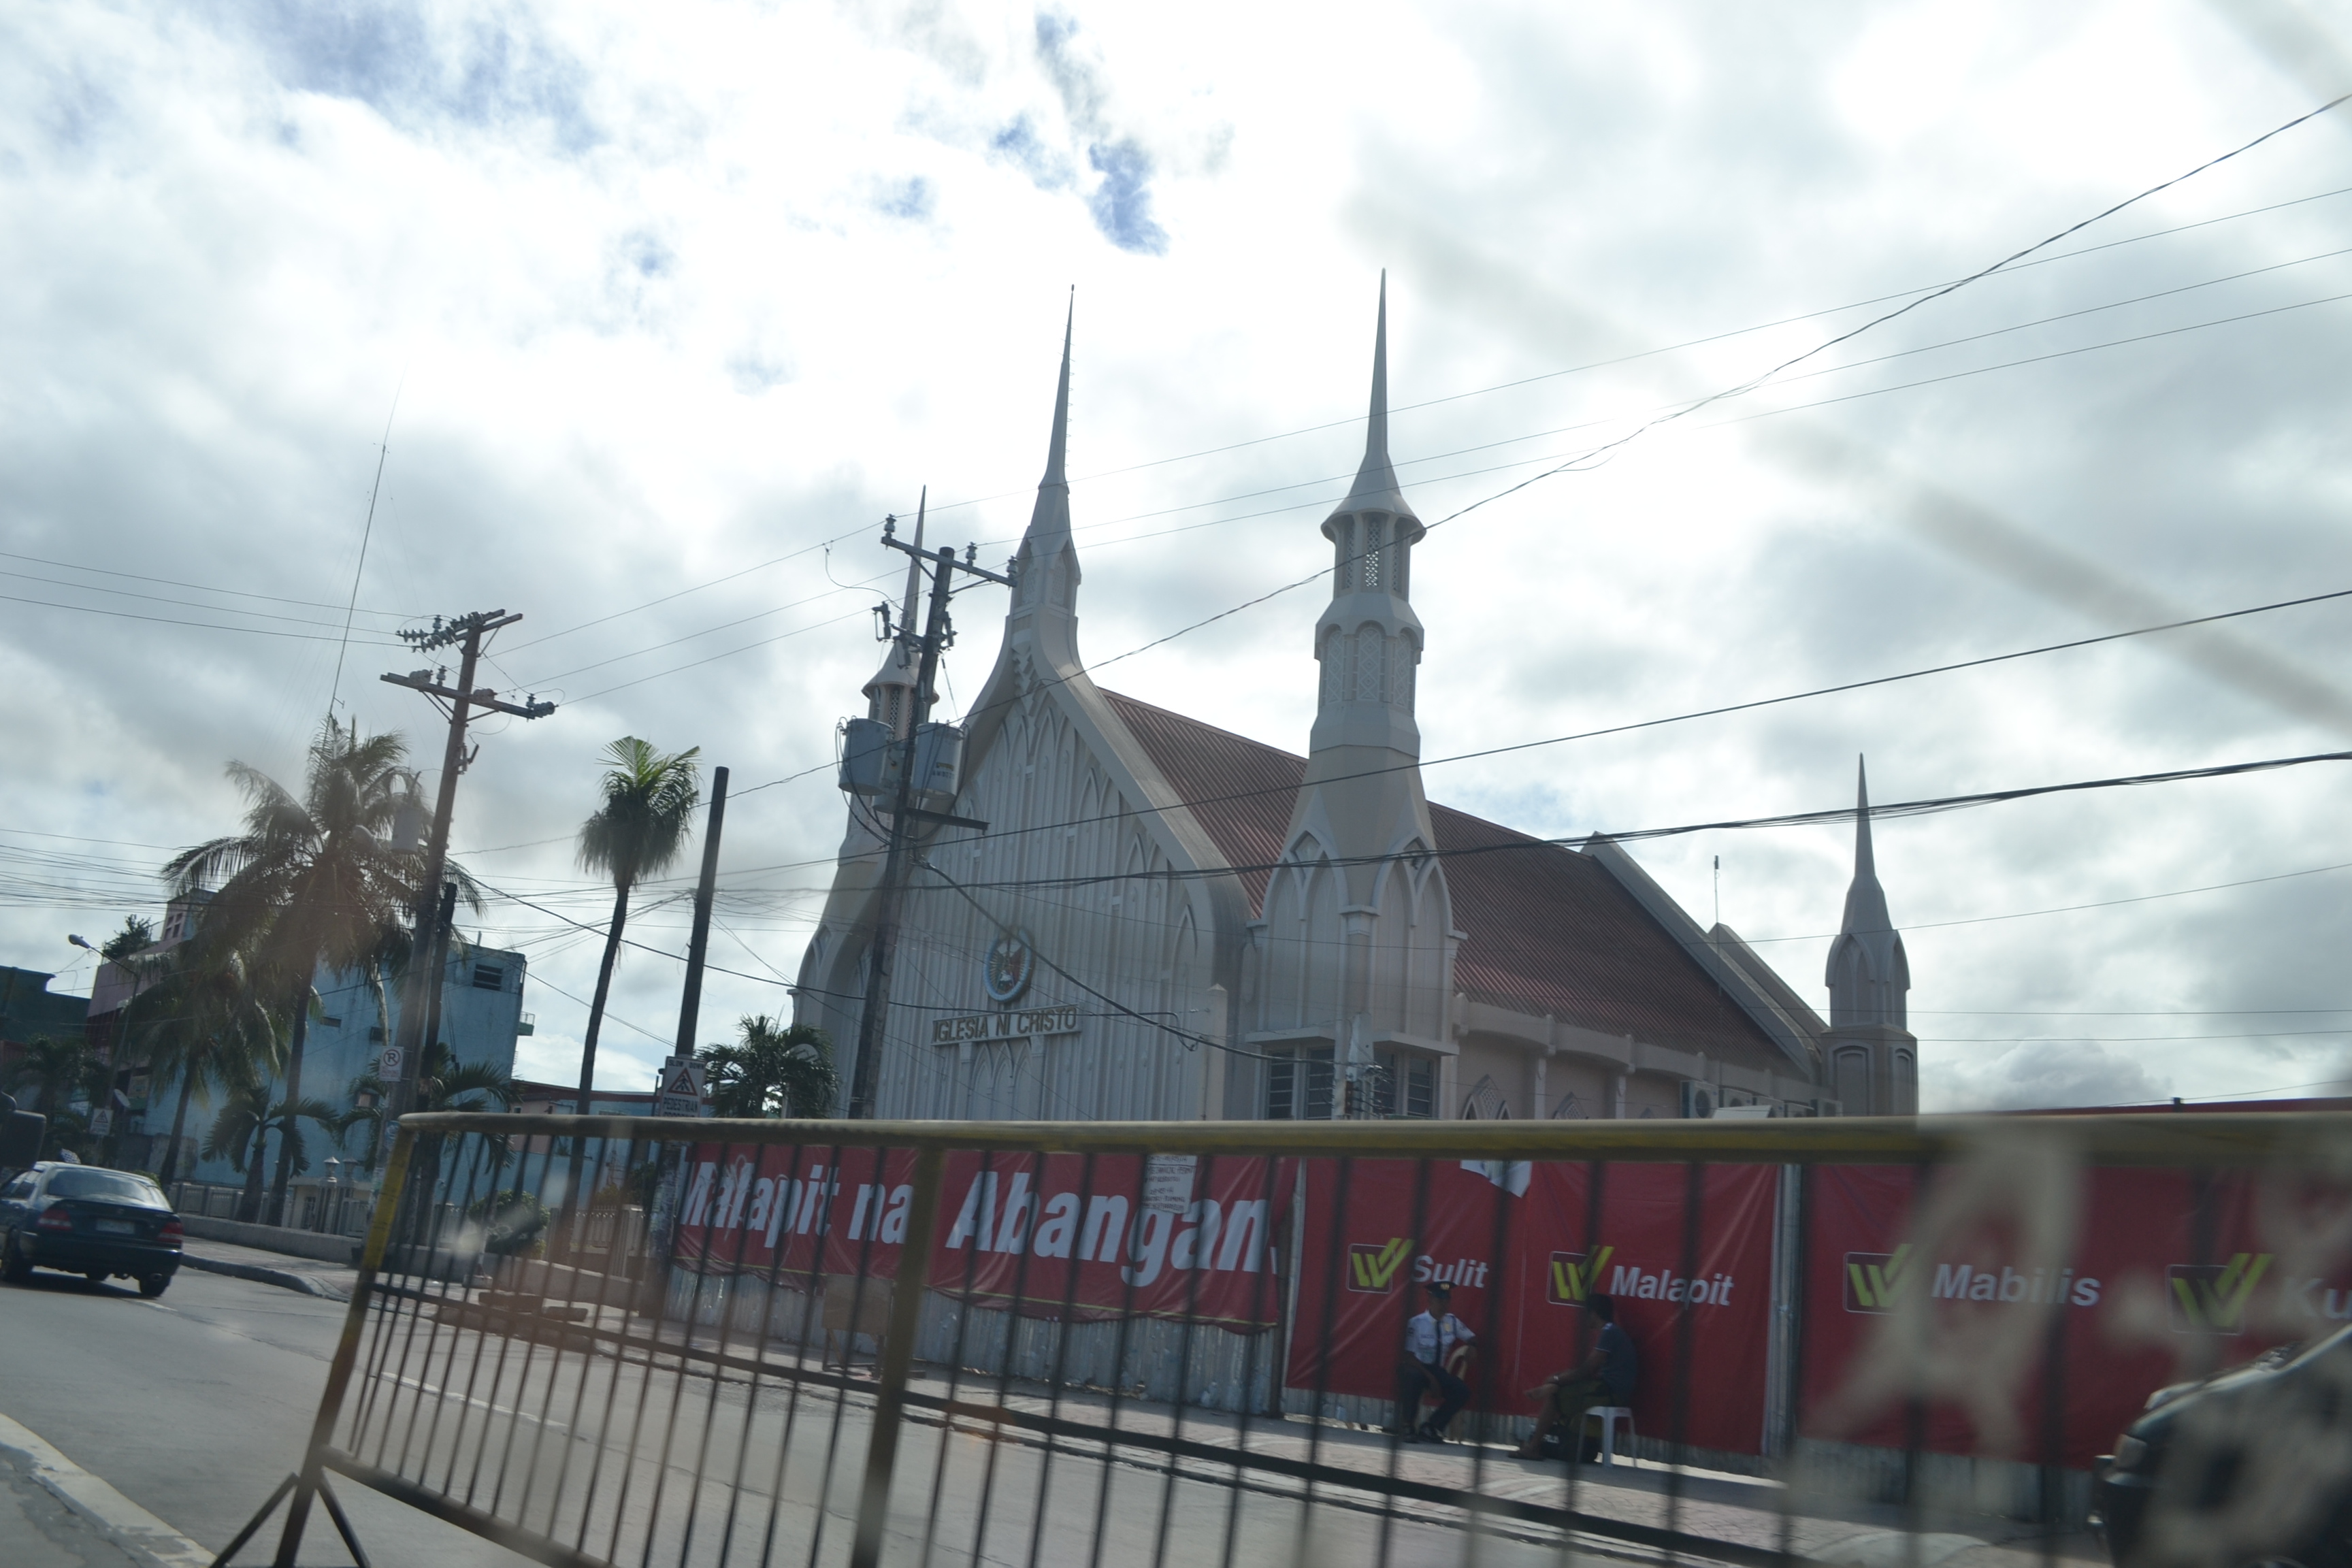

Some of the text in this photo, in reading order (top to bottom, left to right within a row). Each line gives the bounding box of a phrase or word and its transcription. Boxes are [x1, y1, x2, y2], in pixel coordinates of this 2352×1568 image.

[933, 1007, 1077, 1042] IGLESIA NI CRISTO
[847, 1183, 913, 1244] na
[1411, 1255, 1489, 1288] Sulit
[1610, 1266, 1733, 1309] Malapit
[1931, 1263, 2102, 1307] Mabilis
